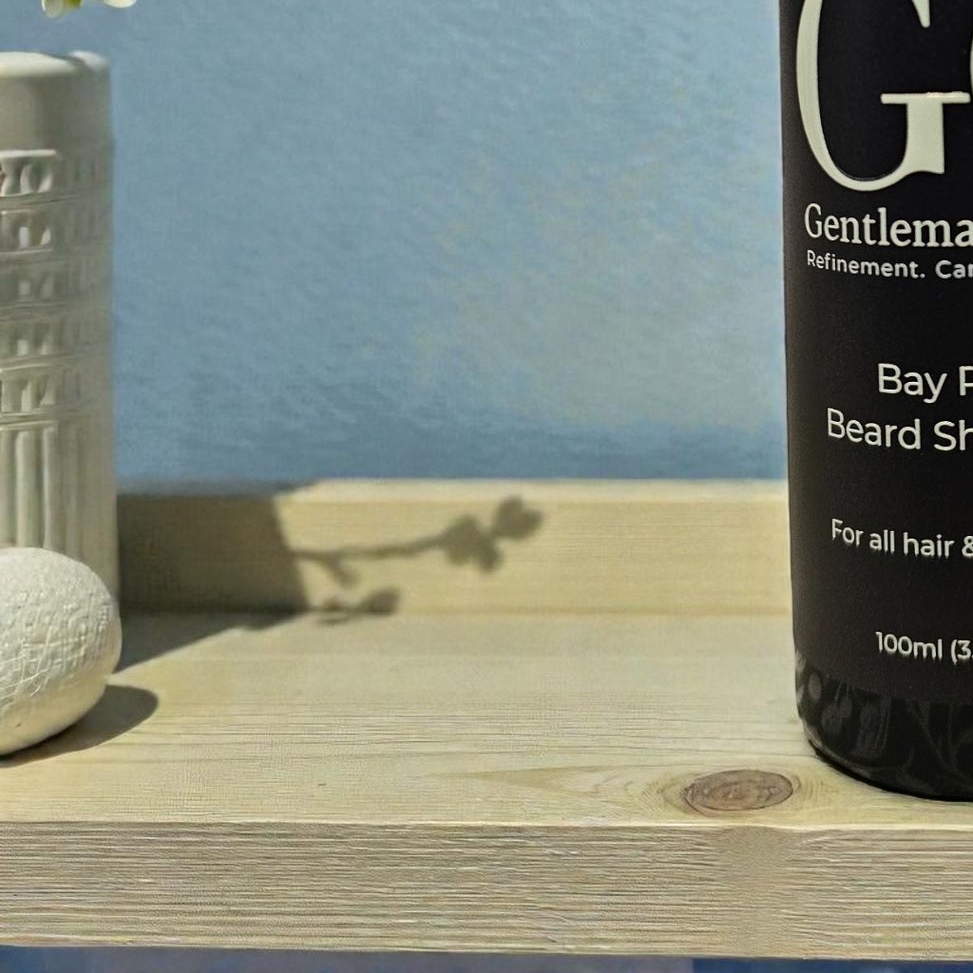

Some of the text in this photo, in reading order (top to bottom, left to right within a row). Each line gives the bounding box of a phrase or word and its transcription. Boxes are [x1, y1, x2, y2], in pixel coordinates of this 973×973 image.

[806, 249, 926, 280] Refinement.
[877, 362, 948, 404] Bay
[826, 407, 922, 451] Beard
[830, 517, 864, 548] For
[869, 529, 896, 554] all
[902, 531, 955, 559] hair
[874, 630, 943, 661] 100ml
